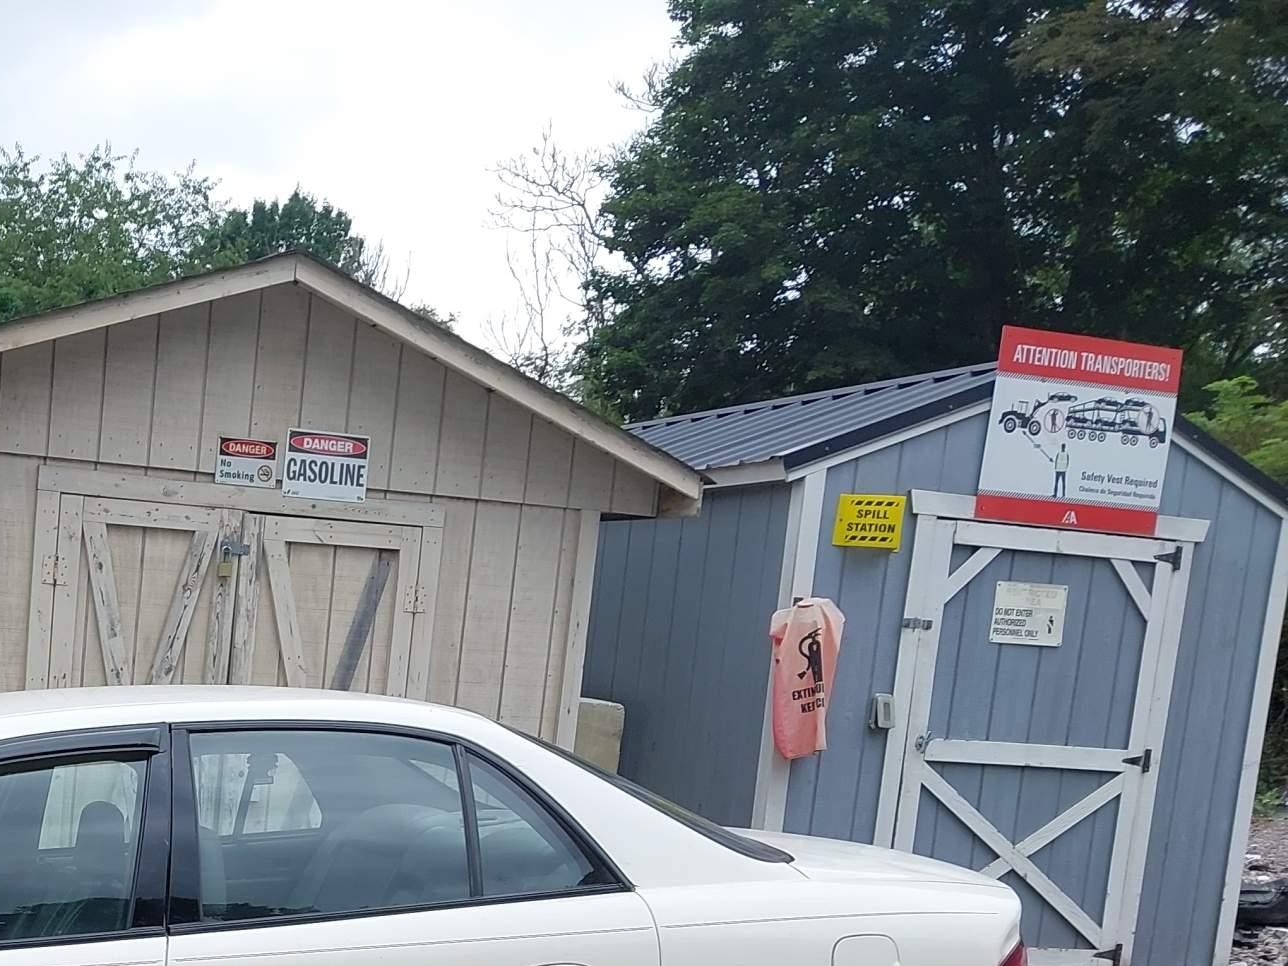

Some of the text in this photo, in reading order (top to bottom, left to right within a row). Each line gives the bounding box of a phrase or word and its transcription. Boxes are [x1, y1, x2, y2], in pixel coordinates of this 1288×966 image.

[1013, 344, 1171, 382] ATTENTION TRANSPORTERS!
[228, 442, 267, 455] DANGER
[303, 436, 354, 453] DANGER
[220, 458, 232, 467] No
[219, 469, 255, 483] Smoking
[286, 457, 366, 487] GASOLINE
[1081, 471, 1158, 489] Safety Vest Required
[856, 508, 889, 520] SPILL
[846, 522, 896, 534] STATION
